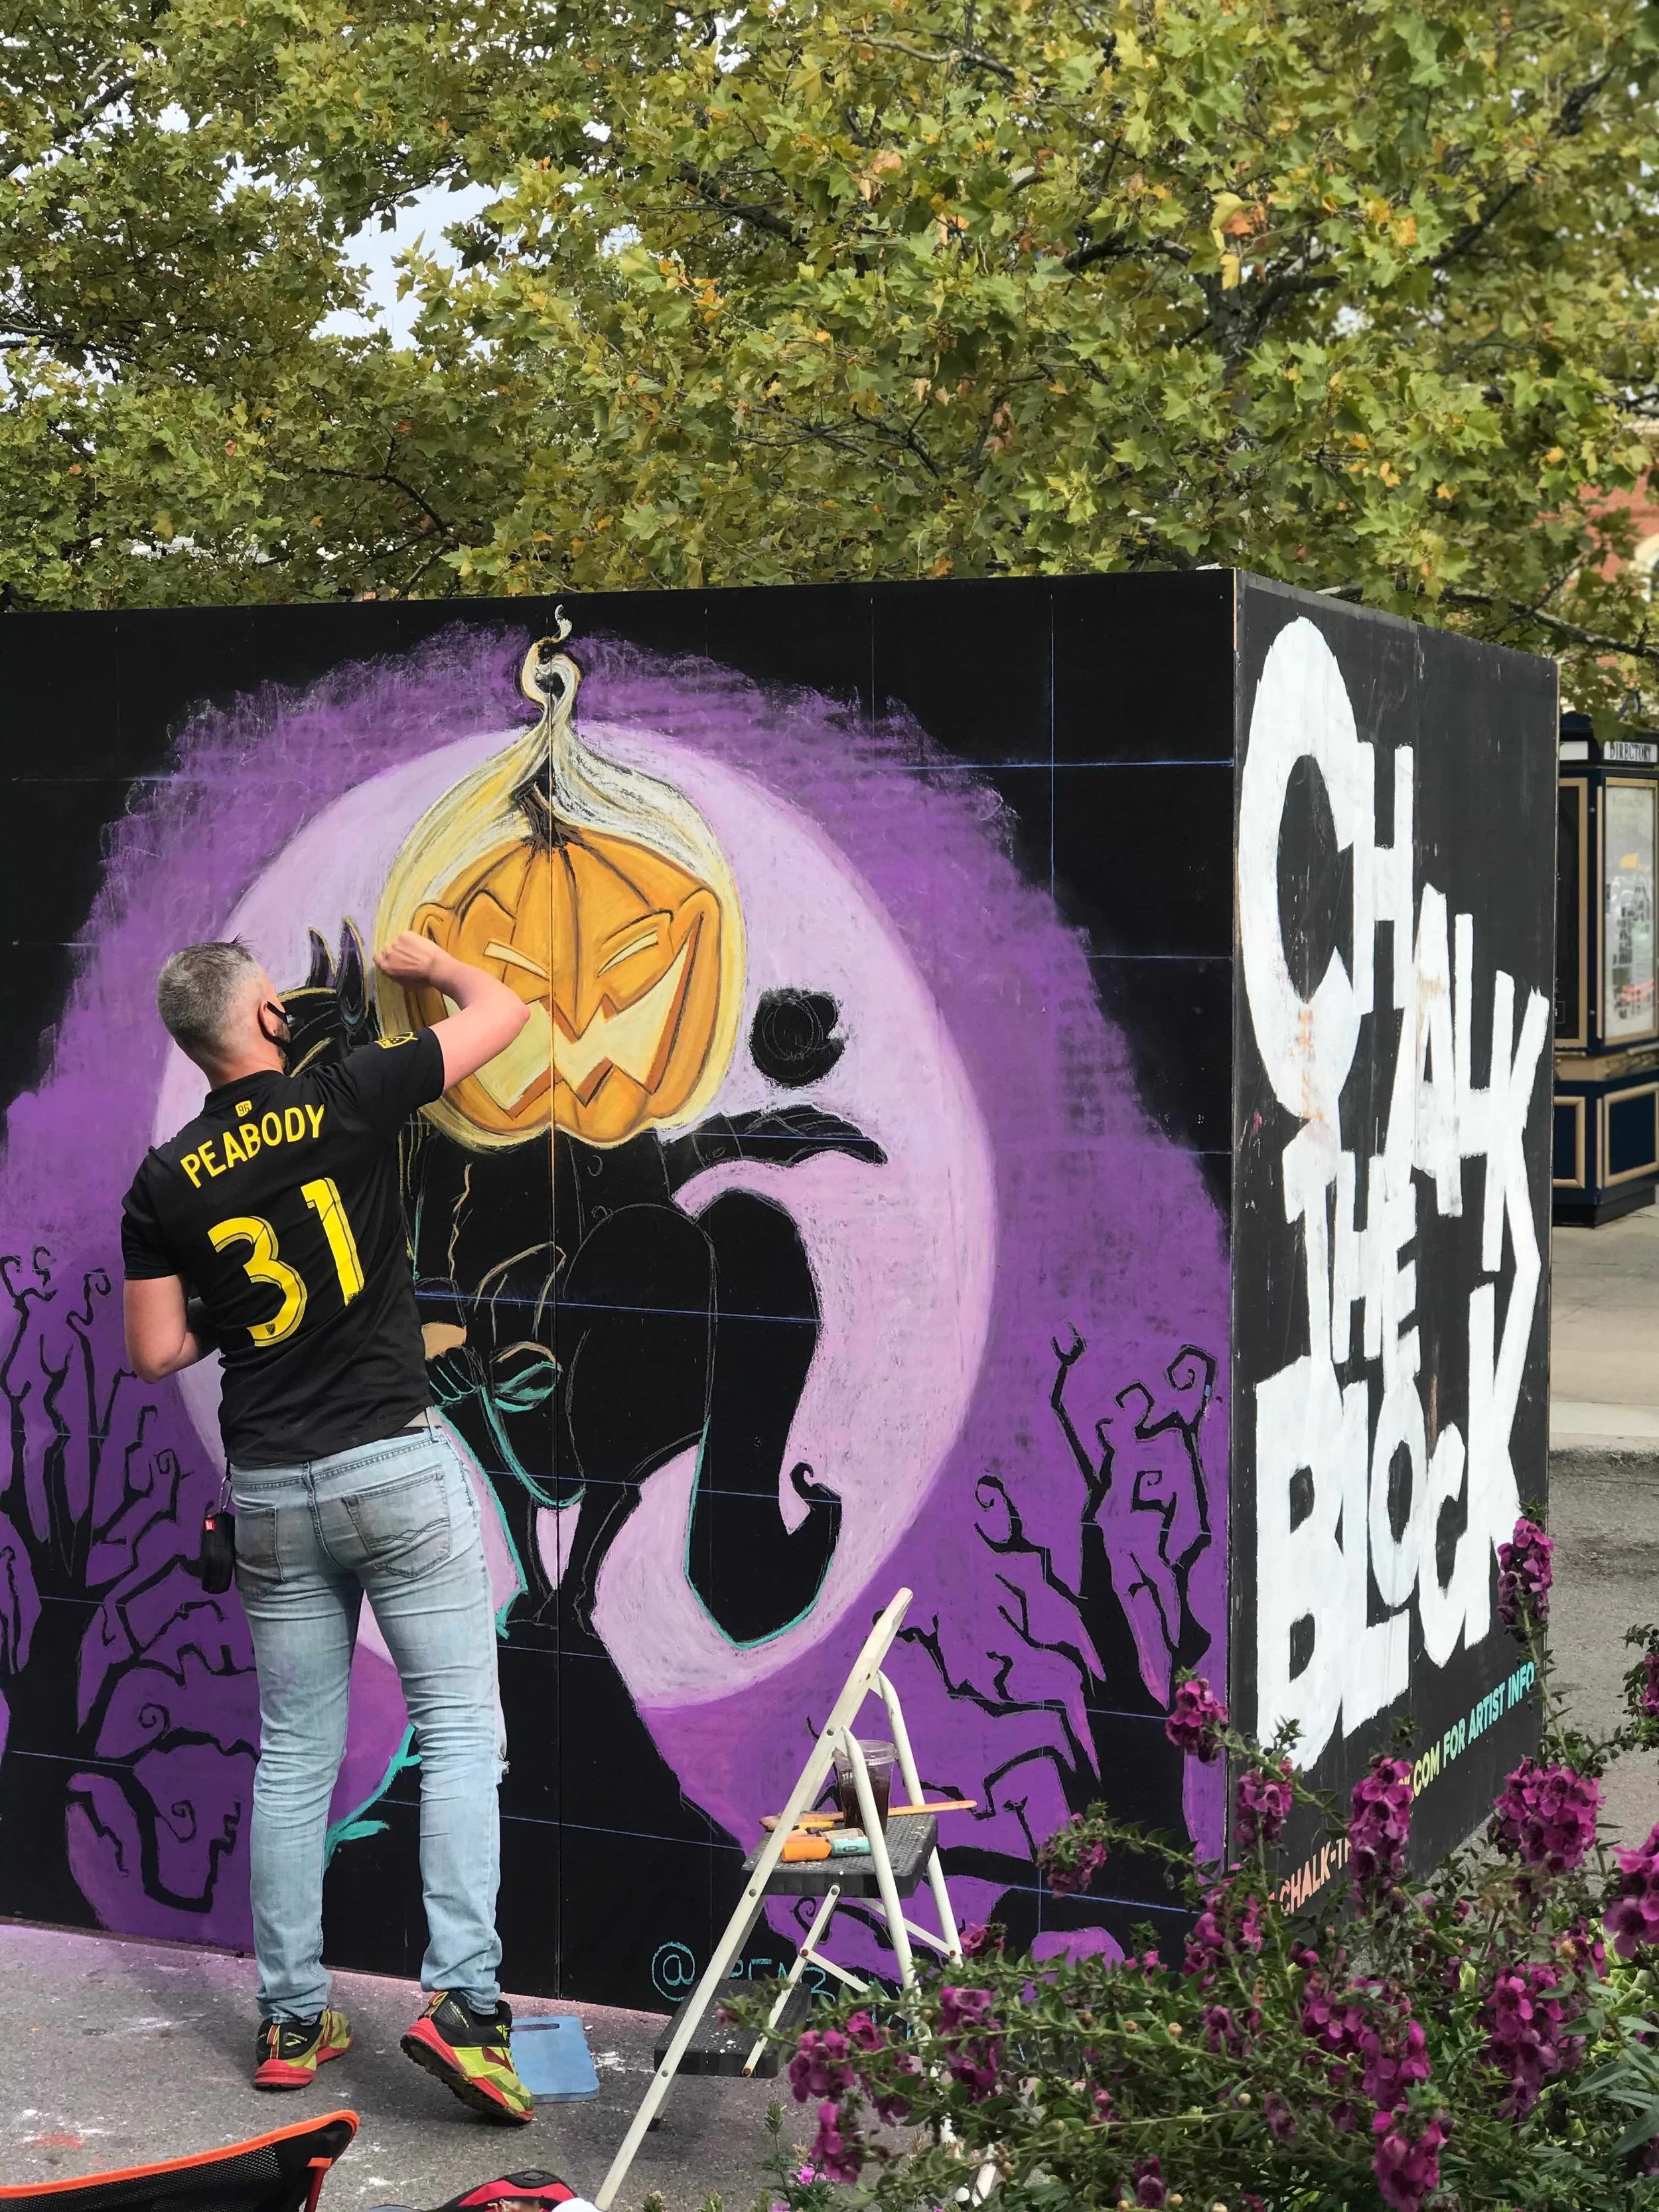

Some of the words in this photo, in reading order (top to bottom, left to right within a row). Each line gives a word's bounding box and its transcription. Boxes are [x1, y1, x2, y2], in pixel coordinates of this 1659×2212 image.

[1610, 742, 1651, 762] DIRECTORY
[1240, 616, 1550, 1272] CHALK
[180, 1103, 326, 1188] PEABODY
[238, 1103, 250, 1116] 96
[207, 1177, 365, 1347] 31
[1282, 1120, 1421, 1394] THE
[1256, 1264, 1541, 1771] BLOCK
[1443, 1718, 1466, 1768] FOR
[1468, 1681, 1506, 1745] ARTIST
[1508, 1661, 1535, 1709] INFO
